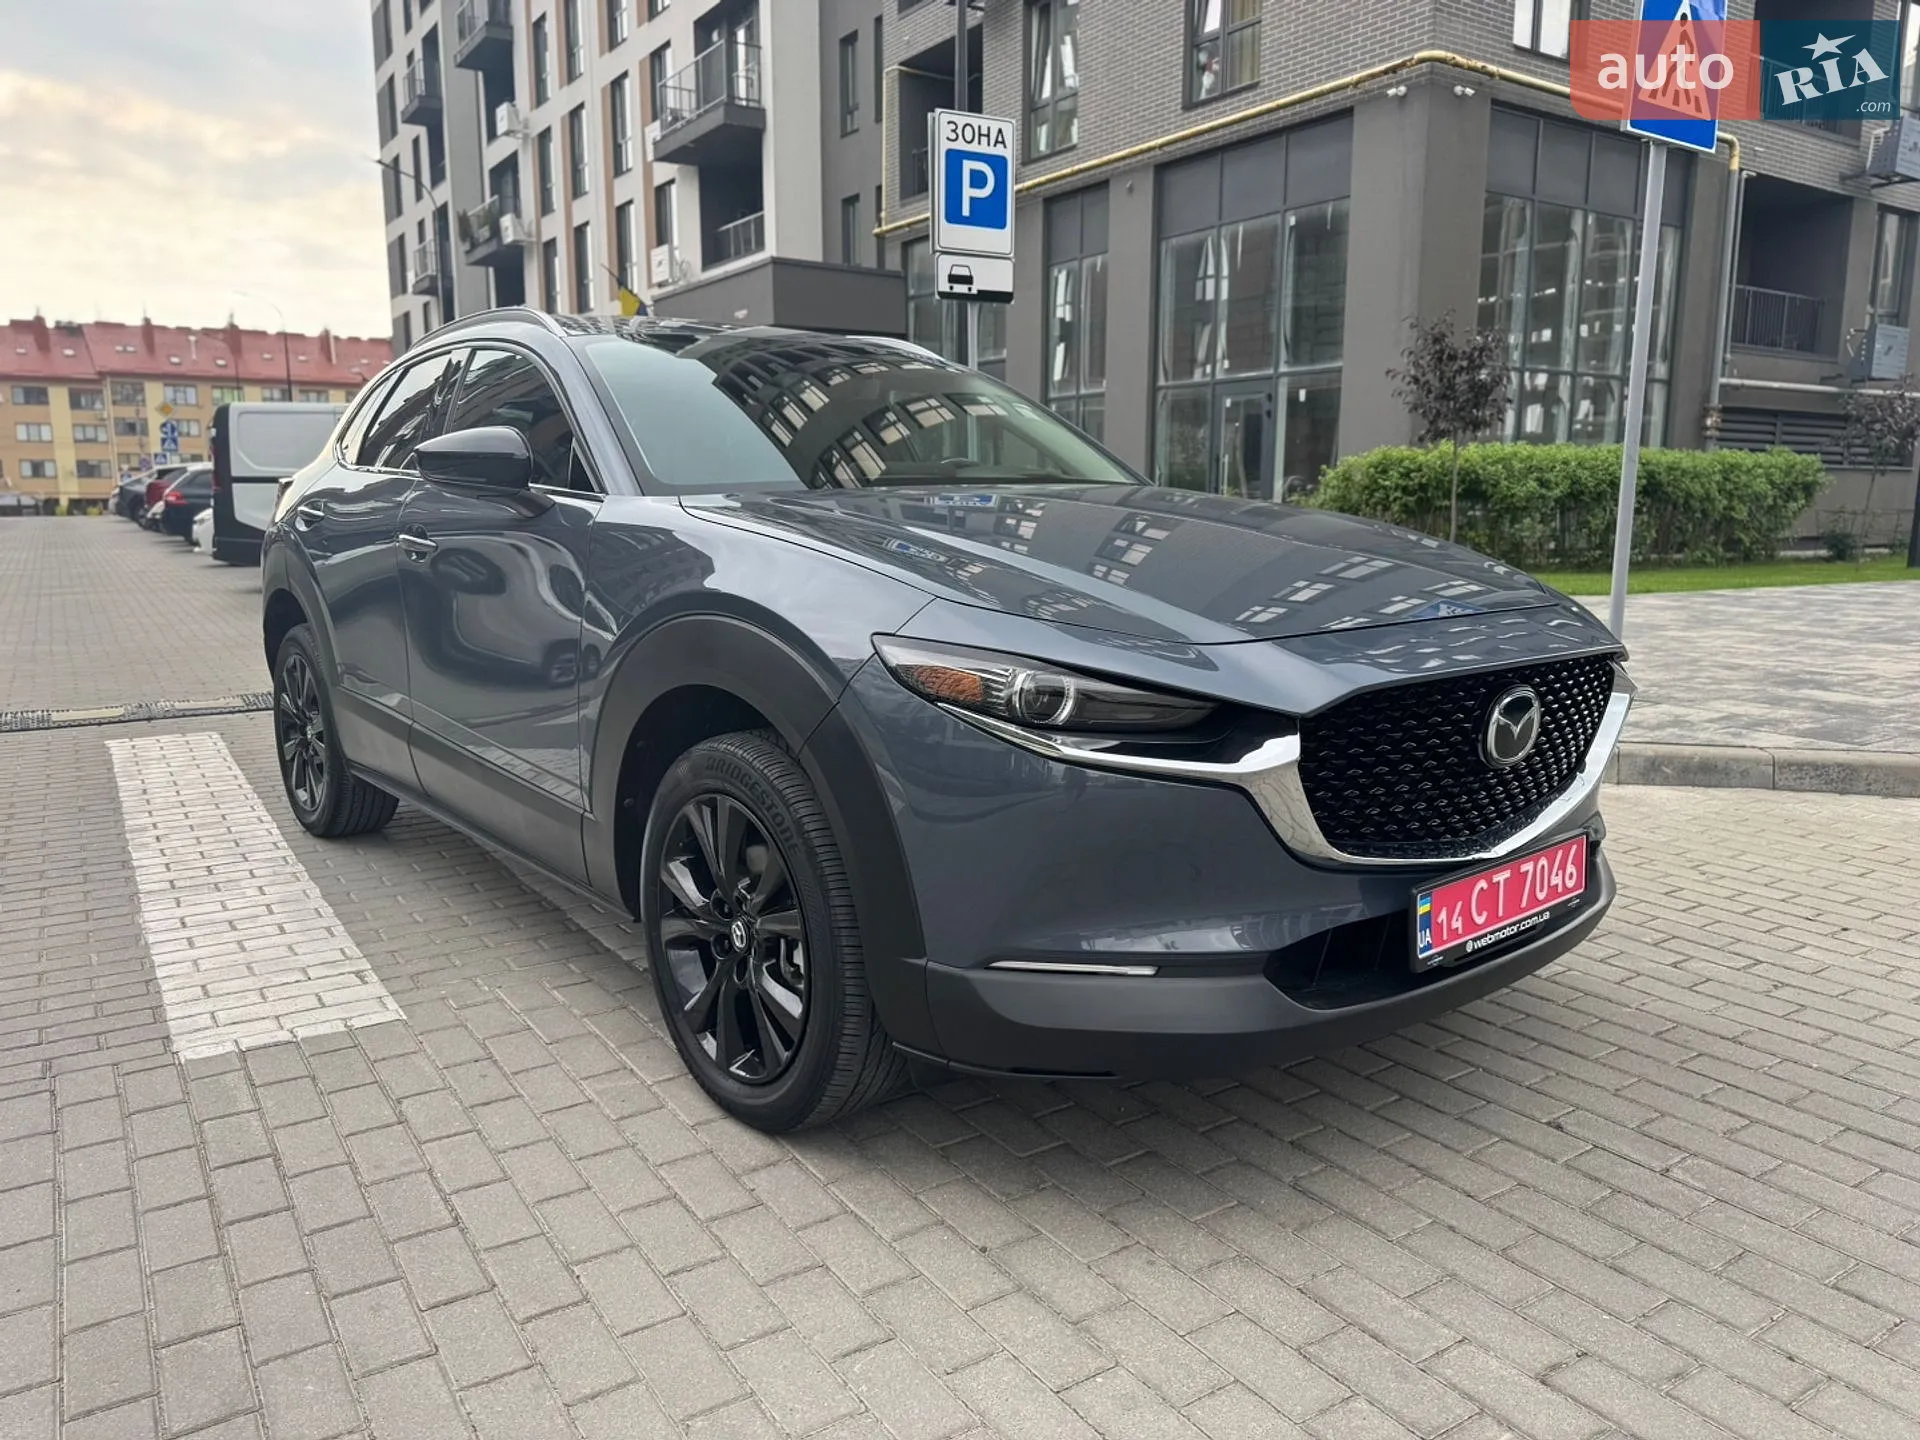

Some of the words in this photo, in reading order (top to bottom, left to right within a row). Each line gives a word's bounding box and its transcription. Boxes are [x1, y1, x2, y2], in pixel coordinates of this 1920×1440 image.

[945, 120, 1008, 149] ЗОНА
[961, 158, 996, 218] P
[704, 755, 802, 857] BRIDGESTONE
[1519, 843, 1578, 909] 7046
[1418, 929, 1433, 949] UA
[1465, 910, 1551, 953] @webmotor.com.ua
